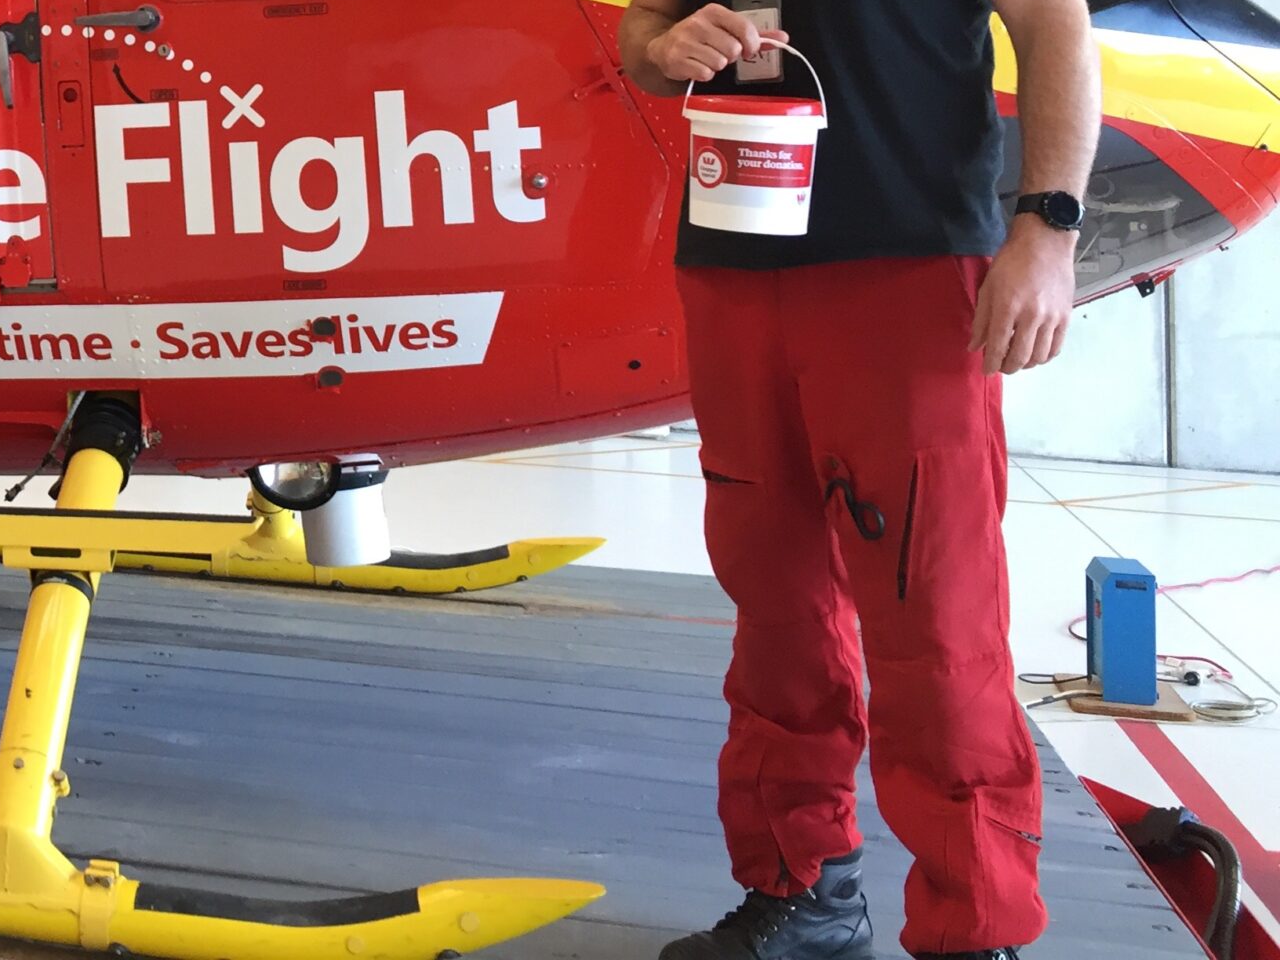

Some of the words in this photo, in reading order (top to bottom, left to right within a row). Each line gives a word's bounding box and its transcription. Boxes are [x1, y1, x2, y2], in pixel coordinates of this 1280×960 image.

[737, 147, 778, 160] Thanks
[778, 150, 793, 161] for
[737, 158, 762, 169] your
[93, 83, 547, 273] Flight
[155, 320, 314, 361] Saves
[330, 313, 459, 356] lives
